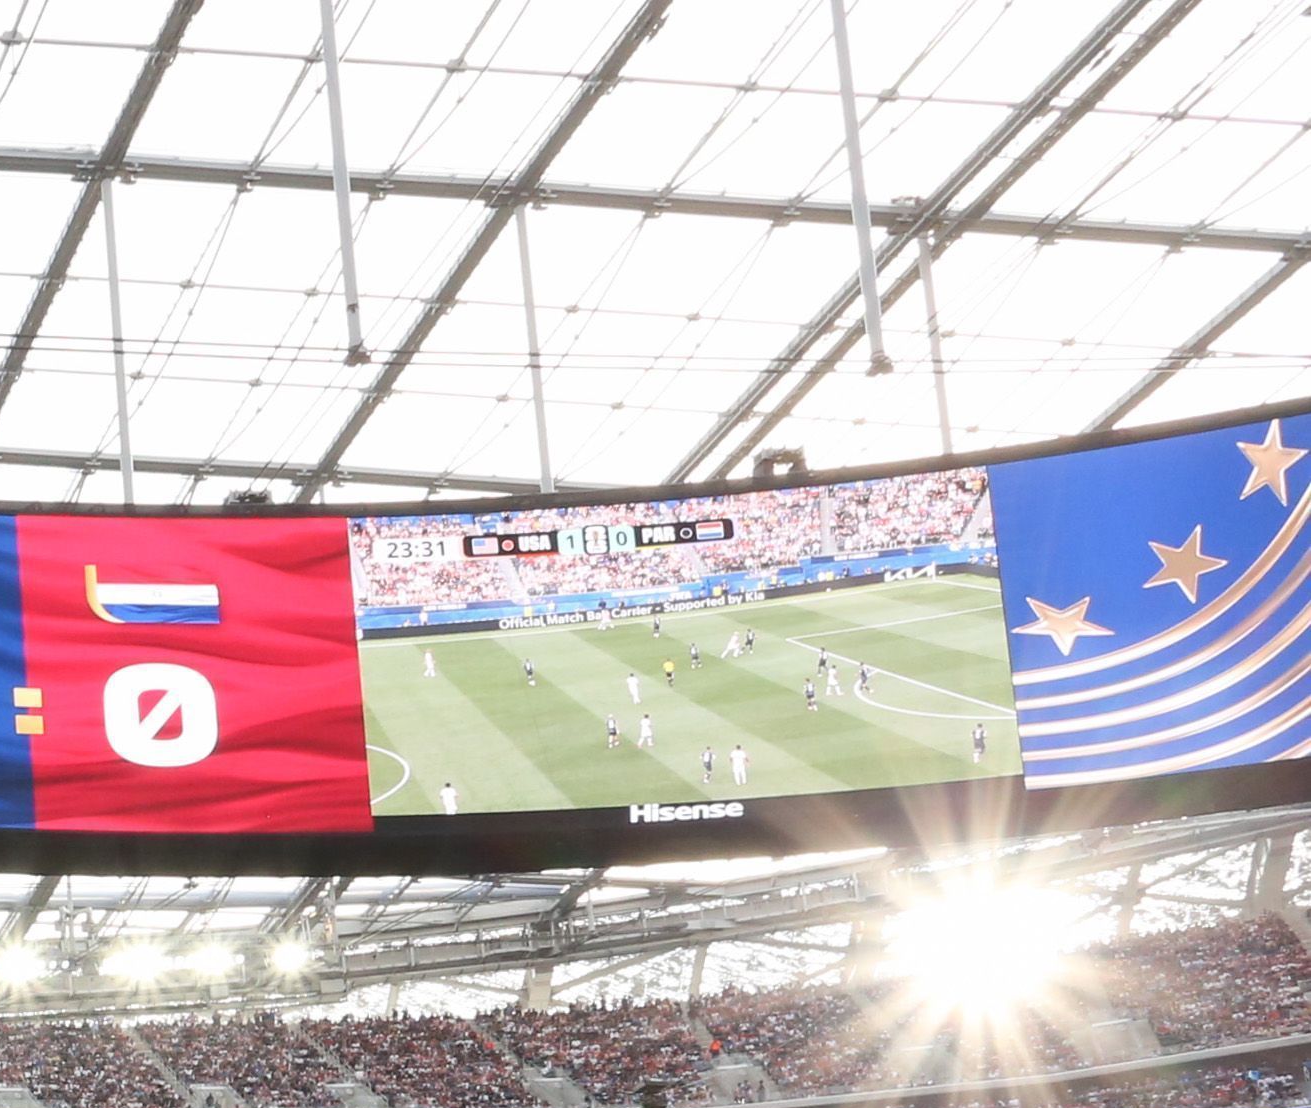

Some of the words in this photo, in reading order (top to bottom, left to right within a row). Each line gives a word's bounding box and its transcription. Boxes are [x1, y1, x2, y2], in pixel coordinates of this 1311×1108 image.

[387, 541, 446, 560] 23:31
[519, 534, 551, 552] USA
[567, 535, 575, 550] 1
[616, 531, 627, 546] 0
[641, 525, 675, 544] PAR
[499, 615, 546, 630] Official
[547, 611, 585, 627] Match
[612, 604, 653, 619] Carrier
[664, 597, 725, 618] Supported
[727, 595, 743, 610] by
[103, 662, 219, 767] 0
[630, 802, 744, 823] Hisense
